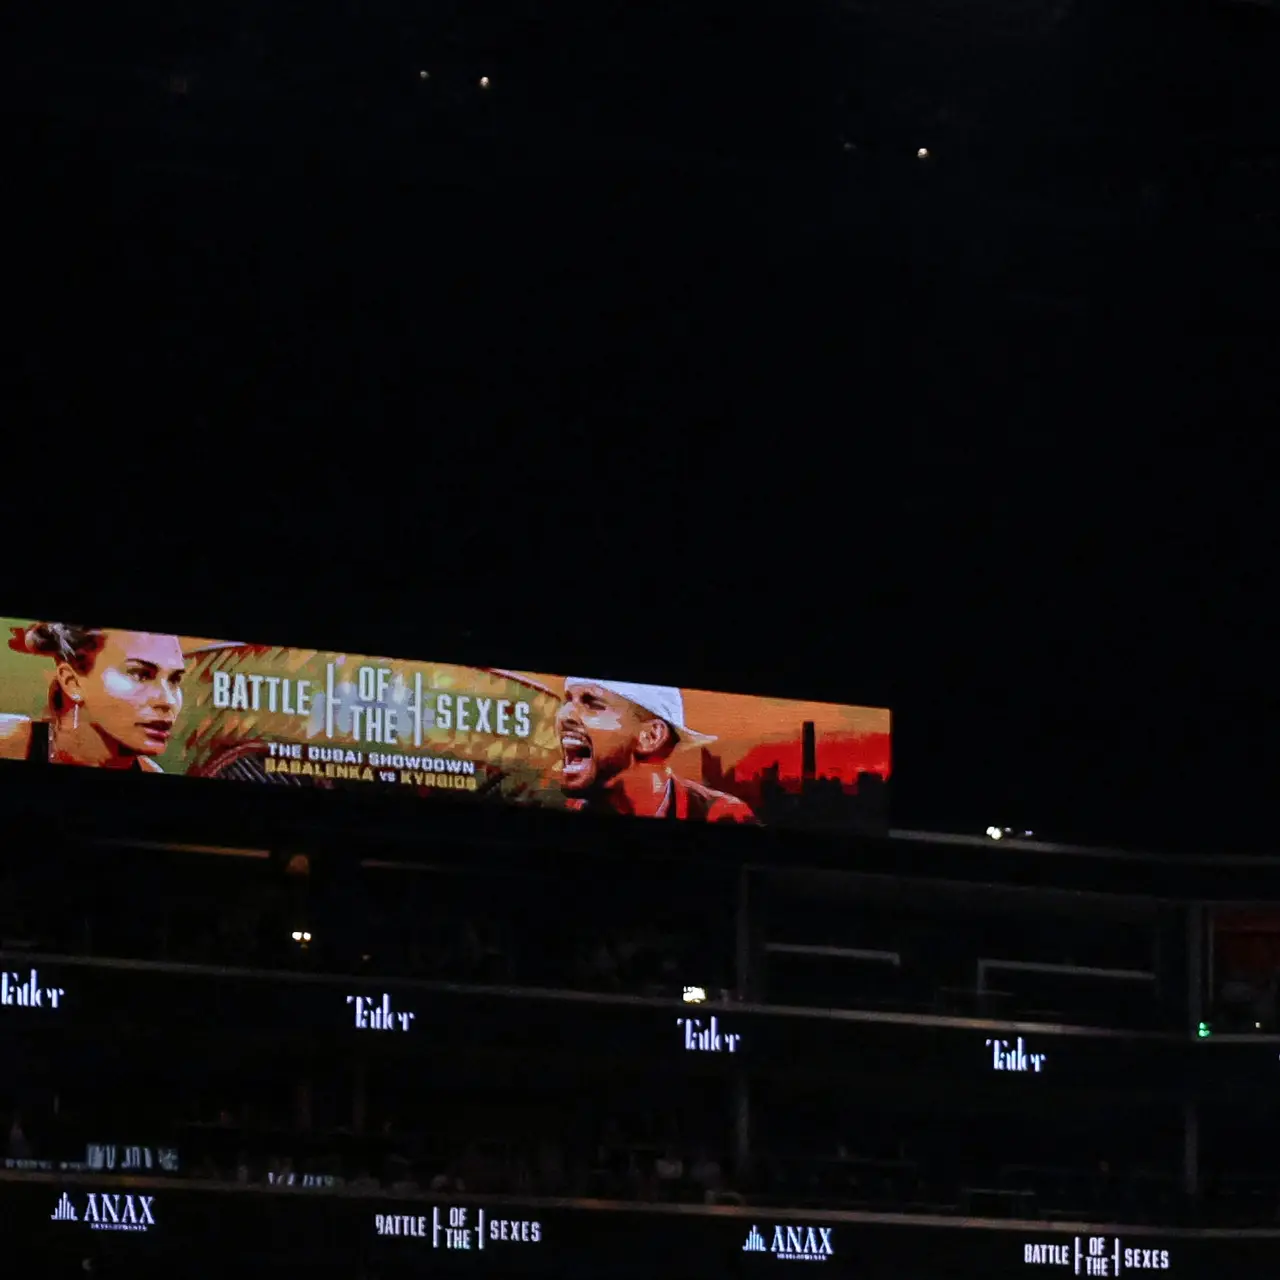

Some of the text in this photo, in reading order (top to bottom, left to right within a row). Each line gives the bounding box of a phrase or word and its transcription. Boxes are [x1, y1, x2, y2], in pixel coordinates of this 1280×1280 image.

[213, 666, 530, 745] BATTLE OF THE SEXES
[268, 742, 476, 775] THE DUBAI SHOWDOWN
[347, 993, 415, 1031] Tatler
[677, 1016, 740, 1052] Tatler
[986, 1037, 1046, 1072] Tatler
[84, 1192, 155, 1225] ANAX
[375, 1207, 542, 1250] BATTLE OF THE SEXES
[771, 1224, 834, 1256] ANAX
[1023, 1236, 1170, 1278] BATTLE OF THE SEXES
